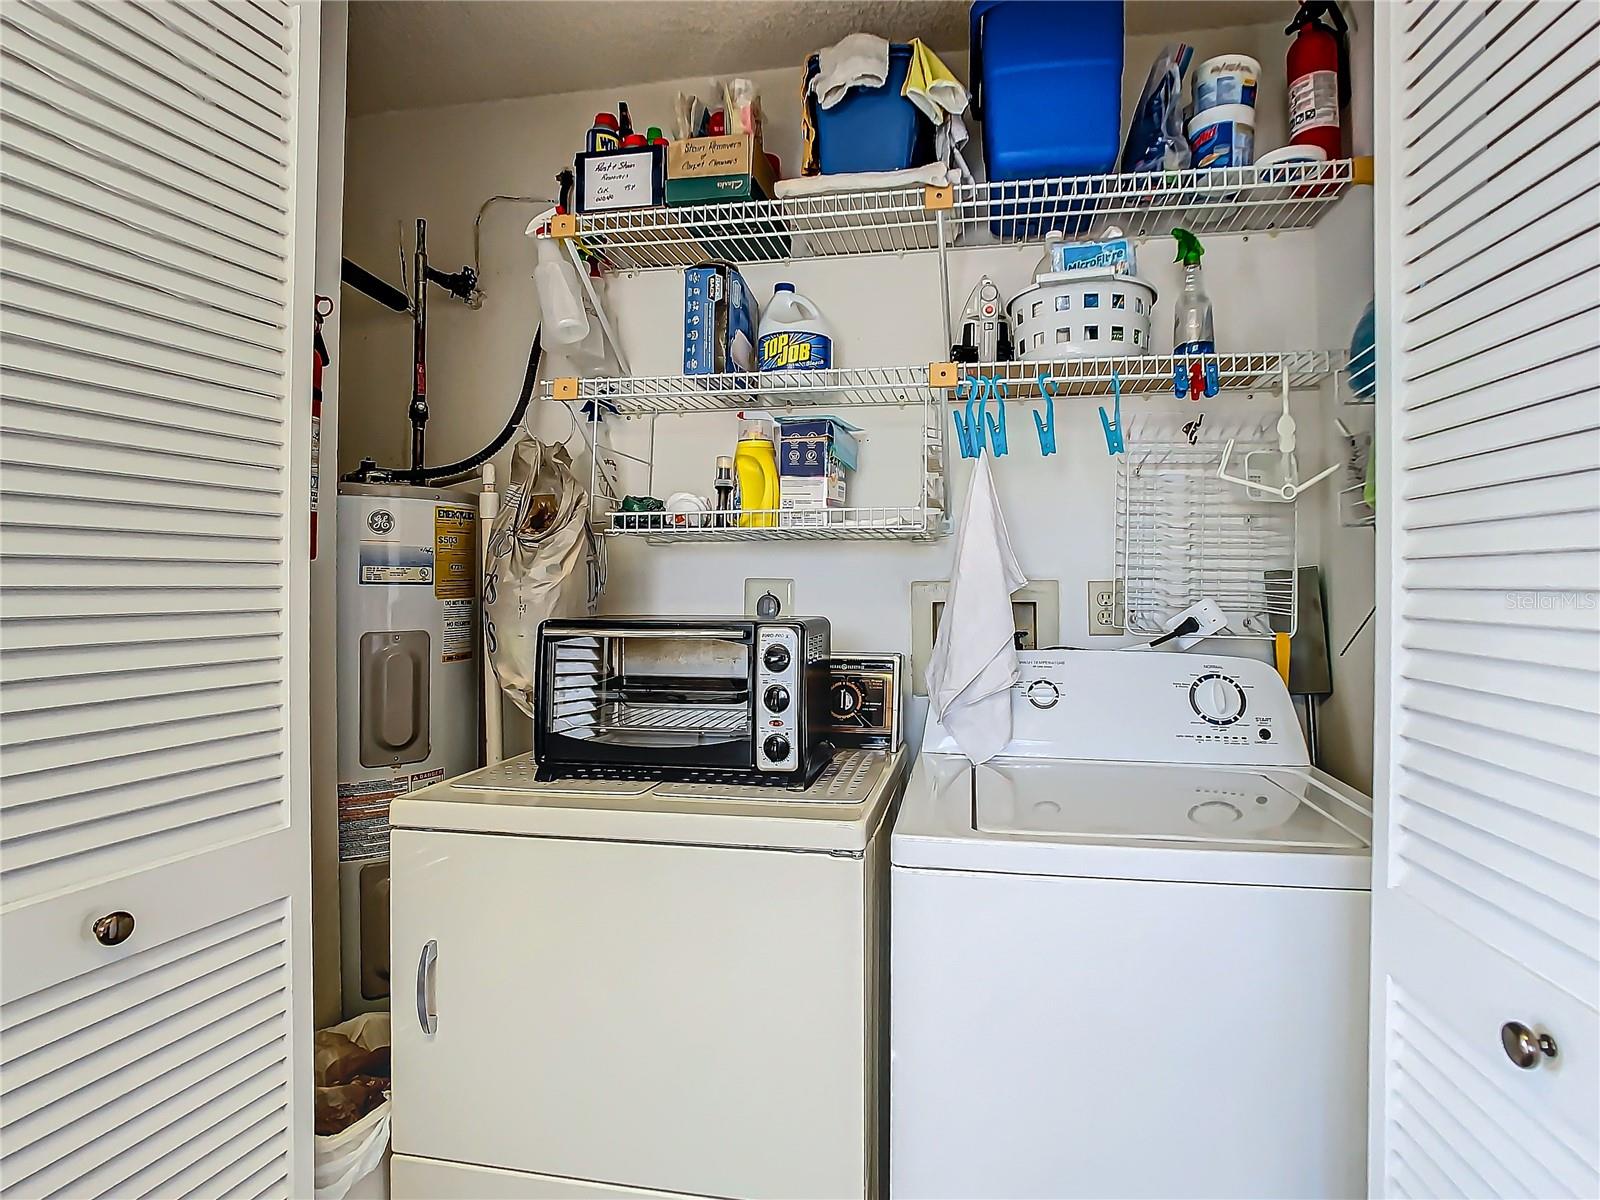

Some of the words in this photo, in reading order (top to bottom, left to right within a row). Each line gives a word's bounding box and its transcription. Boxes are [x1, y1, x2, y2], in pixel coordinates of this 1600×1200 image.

[708, 140, 742, 153] Removers
[764, 333, 789, 361] TOP
[777, 342, 811, 367] JOB
[419, 769, 443, 779] DANGER
